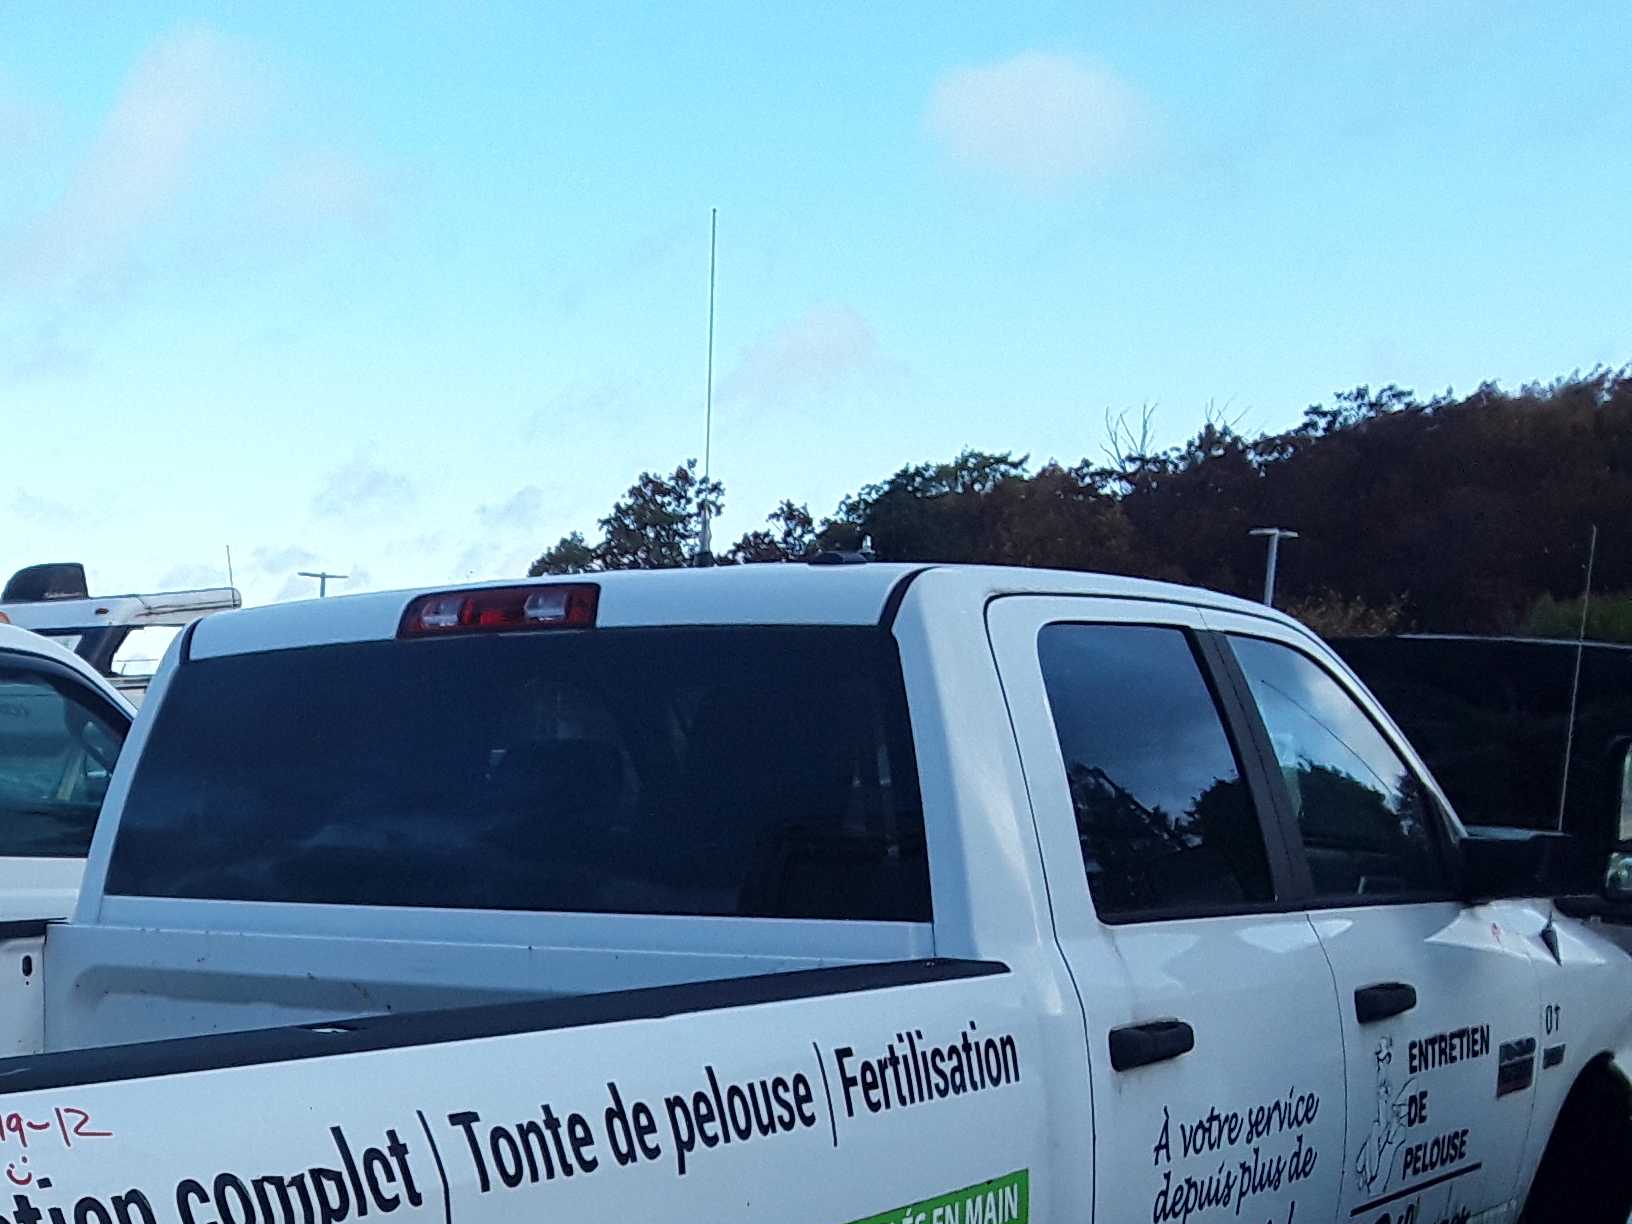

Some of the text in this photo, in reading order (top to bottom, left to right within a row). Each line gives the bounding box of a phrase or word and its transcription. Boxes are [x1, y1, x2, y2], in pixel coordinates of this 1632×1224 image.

[1408, 1025, 1490, 1074] ENTRETIEN
[450, 1104, 598, 1192] Tonte
[607, 1082, 660, 1166] de
[664, 1066, 816, 1174] pelouse
[835, 1021, 1019, 1117] Fertilisation
[1181, 1107, 1243, 1157] votre
[1246, 1086, 1319, 1144] service
[1408, 1090, 1428, 1127] DE
[1236, 1147, 1286, 1216] plus
[1288, 1134, 1317, 1183] de
[1402, 1129, 1469, 1180] PELOUSE
